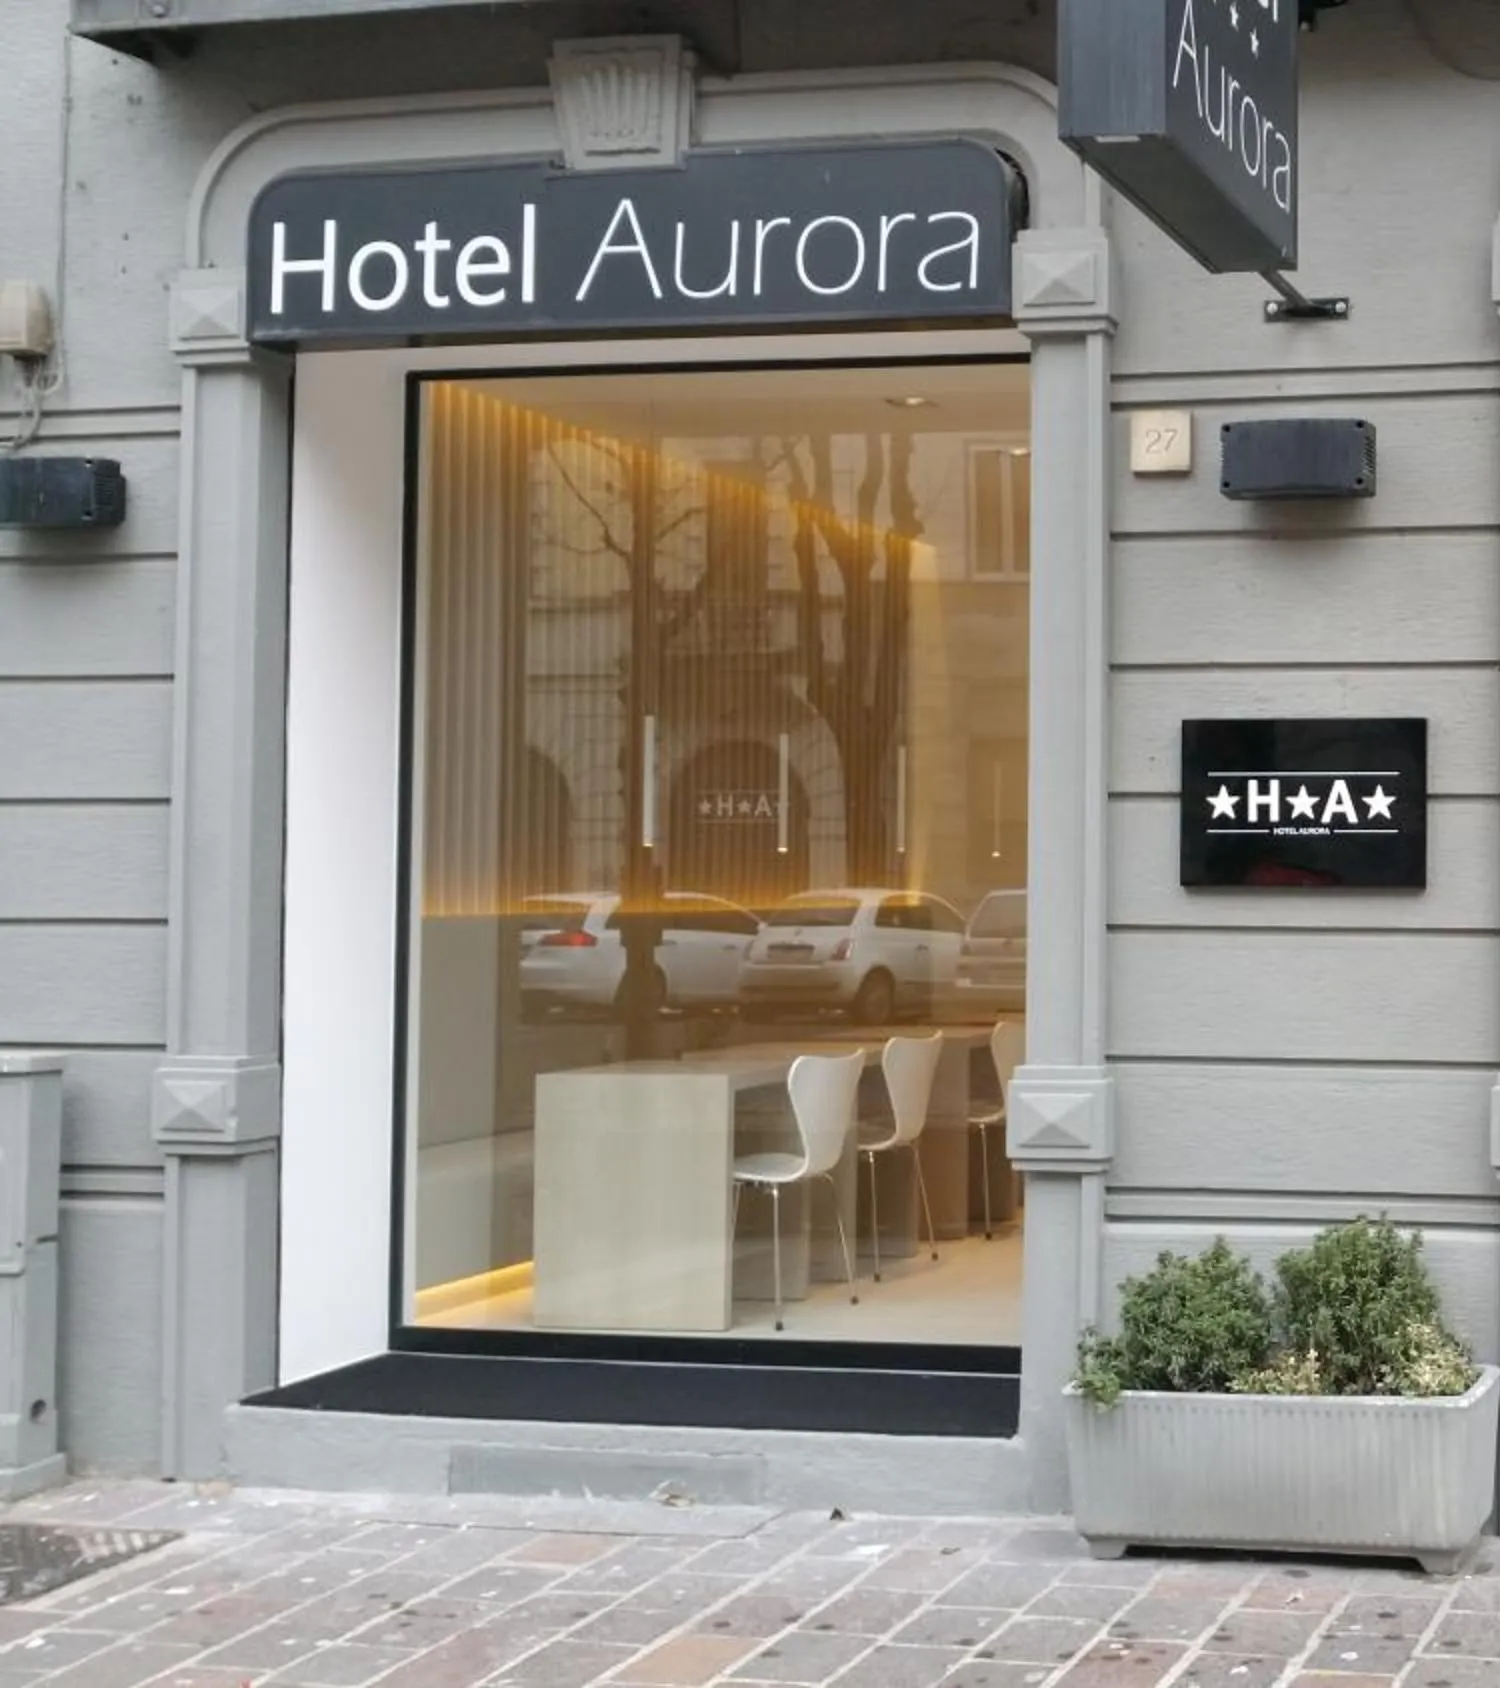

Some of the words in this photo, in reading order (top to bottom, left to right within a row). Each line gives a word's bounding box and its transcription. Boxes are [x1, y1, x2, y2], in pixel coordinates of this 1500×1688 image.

[1173, 0, 1291, 214] Aurora
[269, 202, 537, 315] Hotel
[575, 198, 980, 301] Aurora
[1144, 428, 1179, 455] 27
